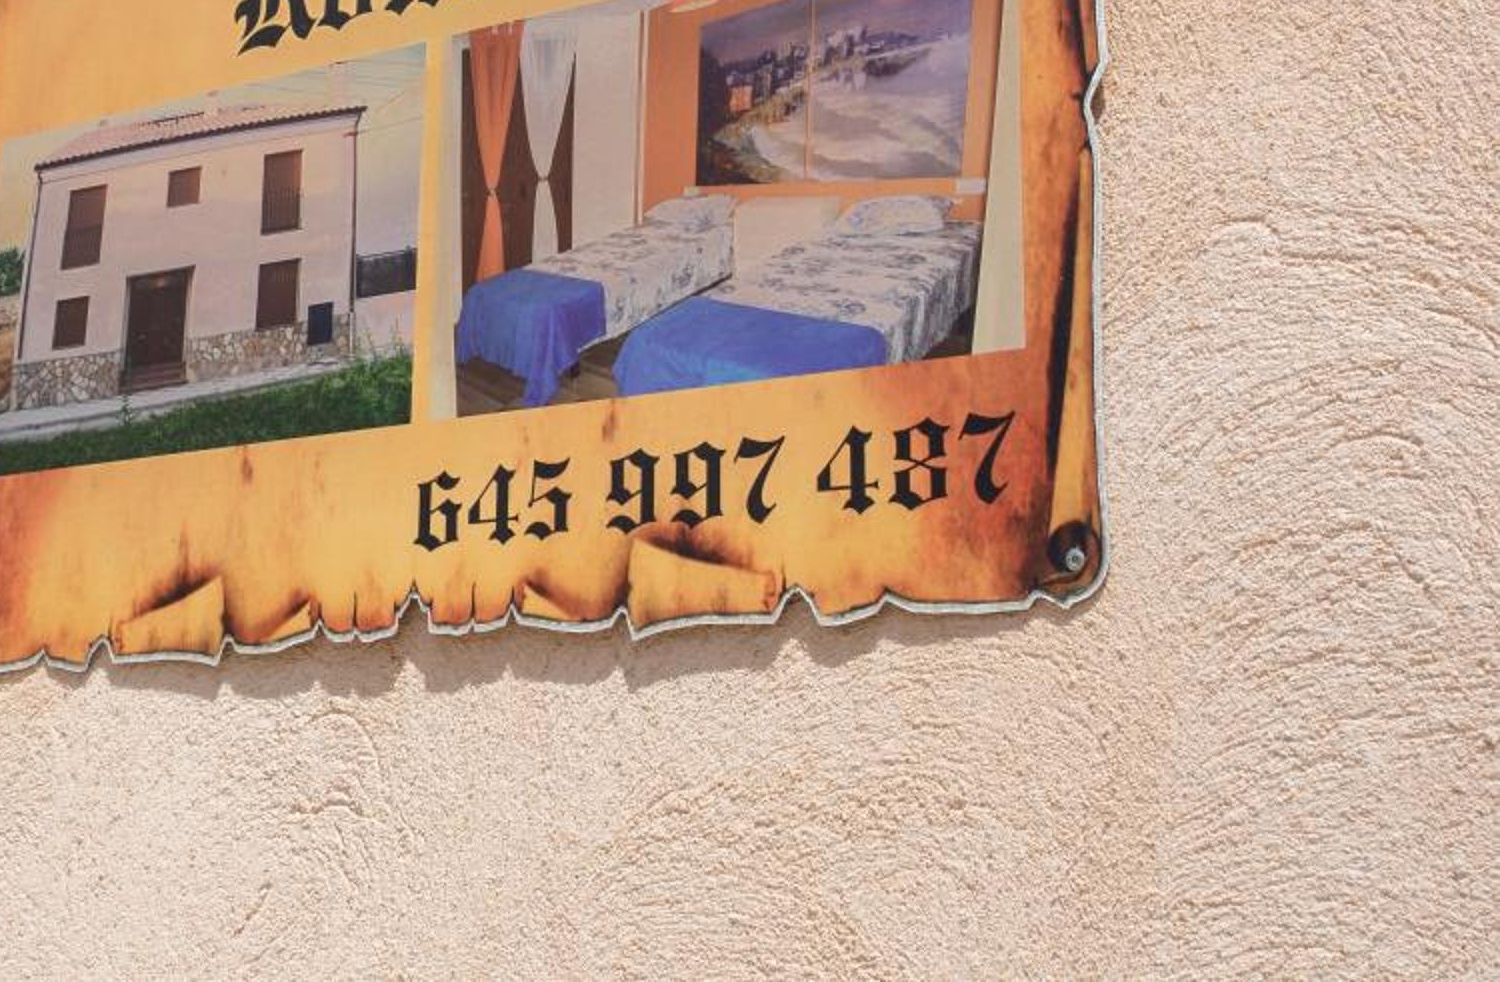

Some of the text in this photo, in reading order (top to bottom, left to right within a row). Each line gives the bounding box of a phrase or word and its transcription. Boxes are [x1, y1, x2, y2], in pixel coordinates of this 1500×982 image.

[414, 411, 1015, 551] 645 997 487
